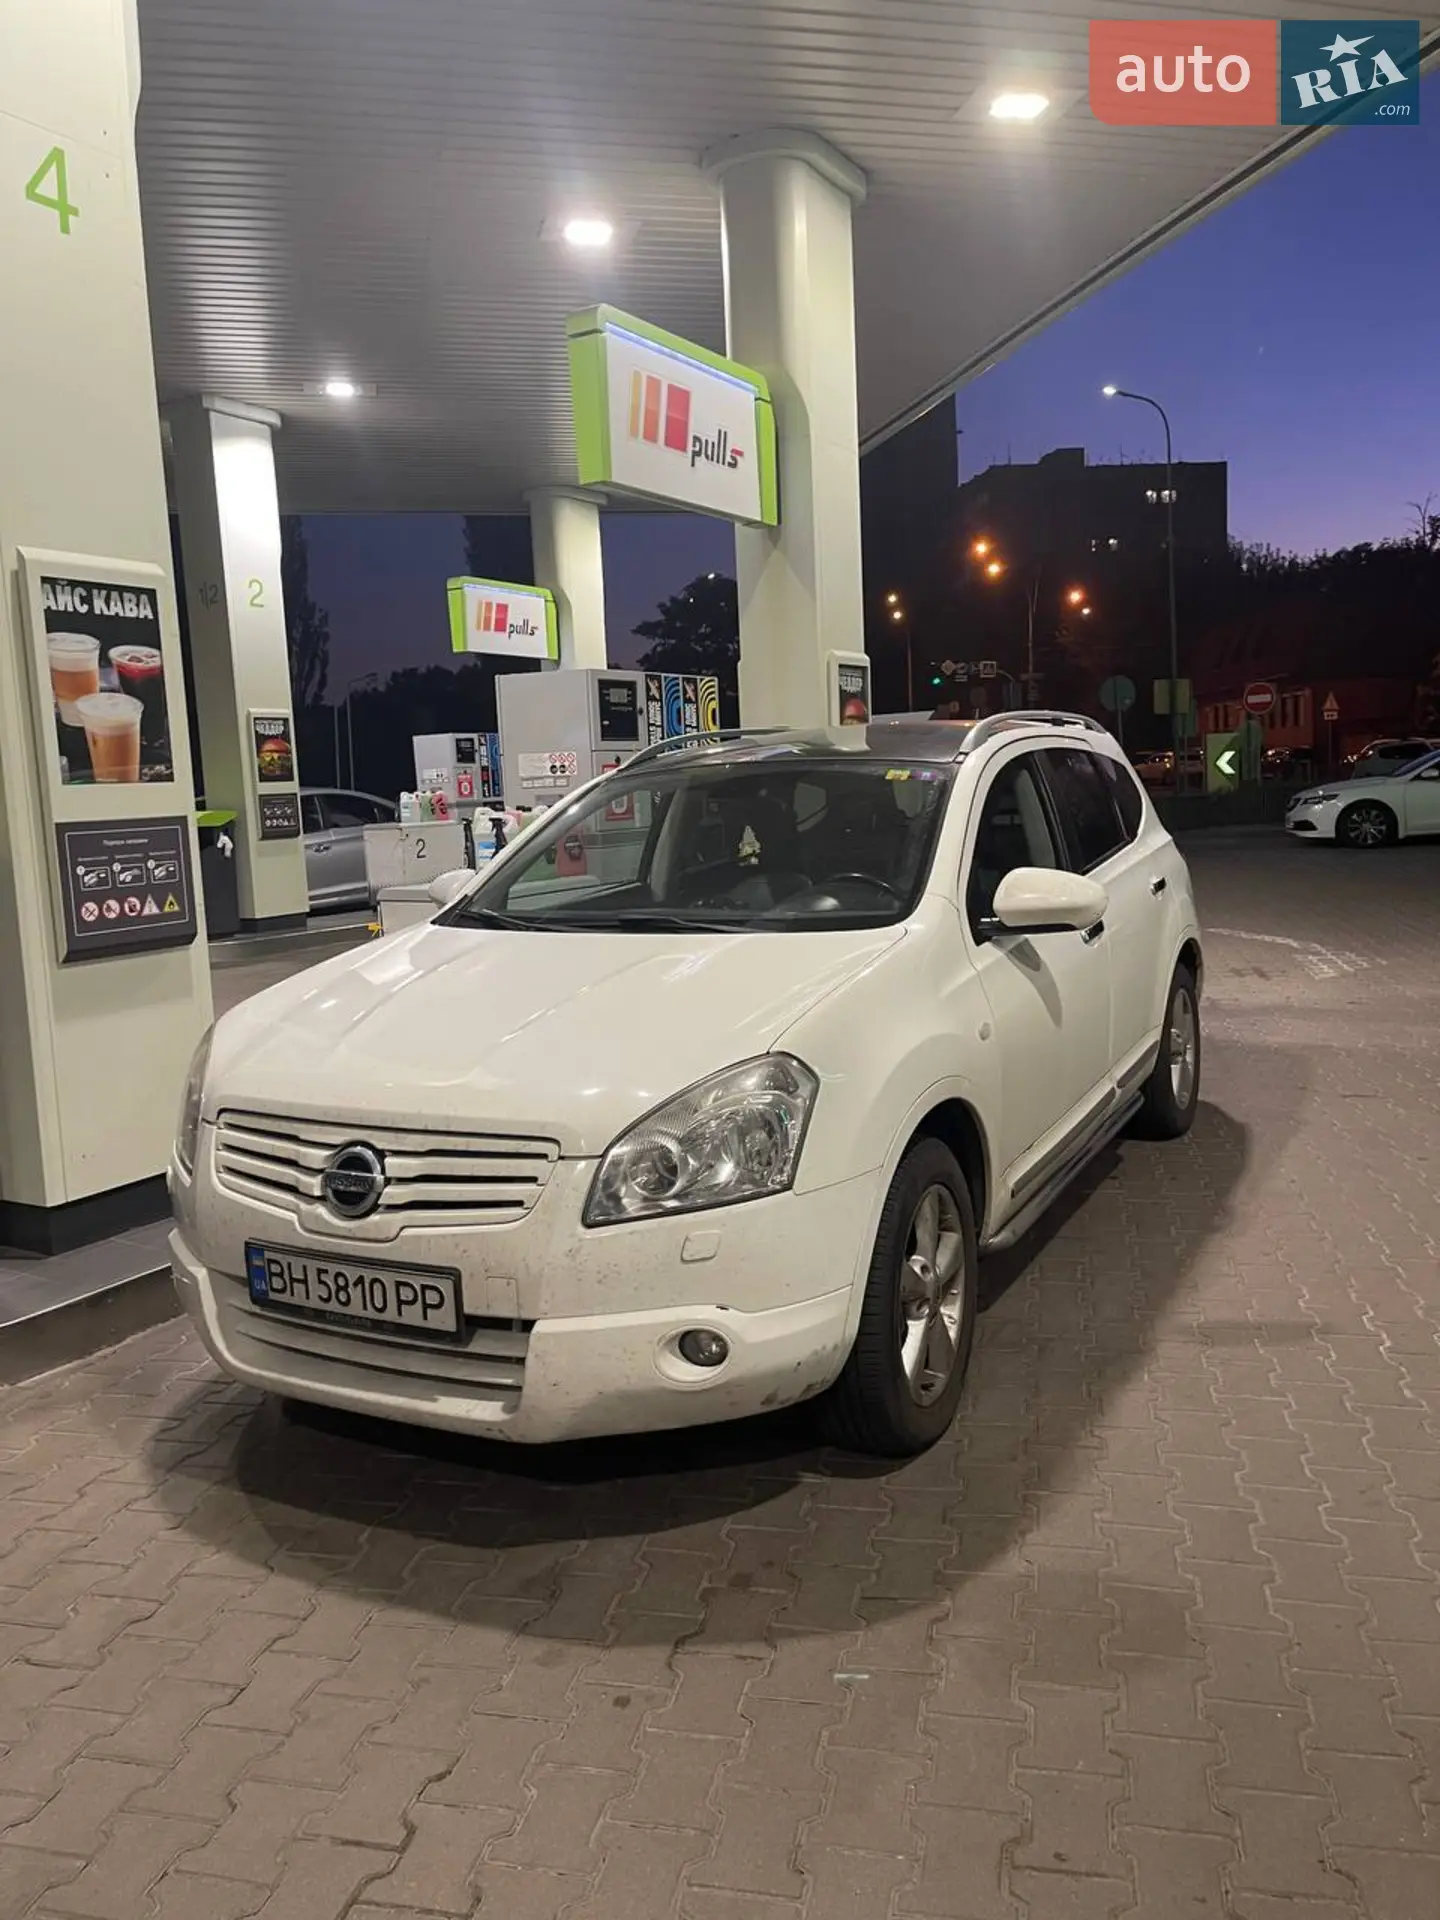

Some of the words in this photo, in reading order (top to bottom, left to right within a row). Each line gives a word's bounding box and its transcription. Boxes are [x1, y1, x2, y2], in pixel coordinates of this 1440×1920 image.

[25, 146, 79, 235] 4
[691, 428, 744, 468] pulls
[43, 580, 89, 613] АЙС
[92, 588, 154, 619] КАВА
[248, 578, 264, 608] 2
[508, 618, 538, 640] pulls
[416, 838, 426, 859] 2
[266, 1257, 310, 1301] BH
[316, 1267, 388, 1315] 5810
[394, 1280, 445, 1321] PP
